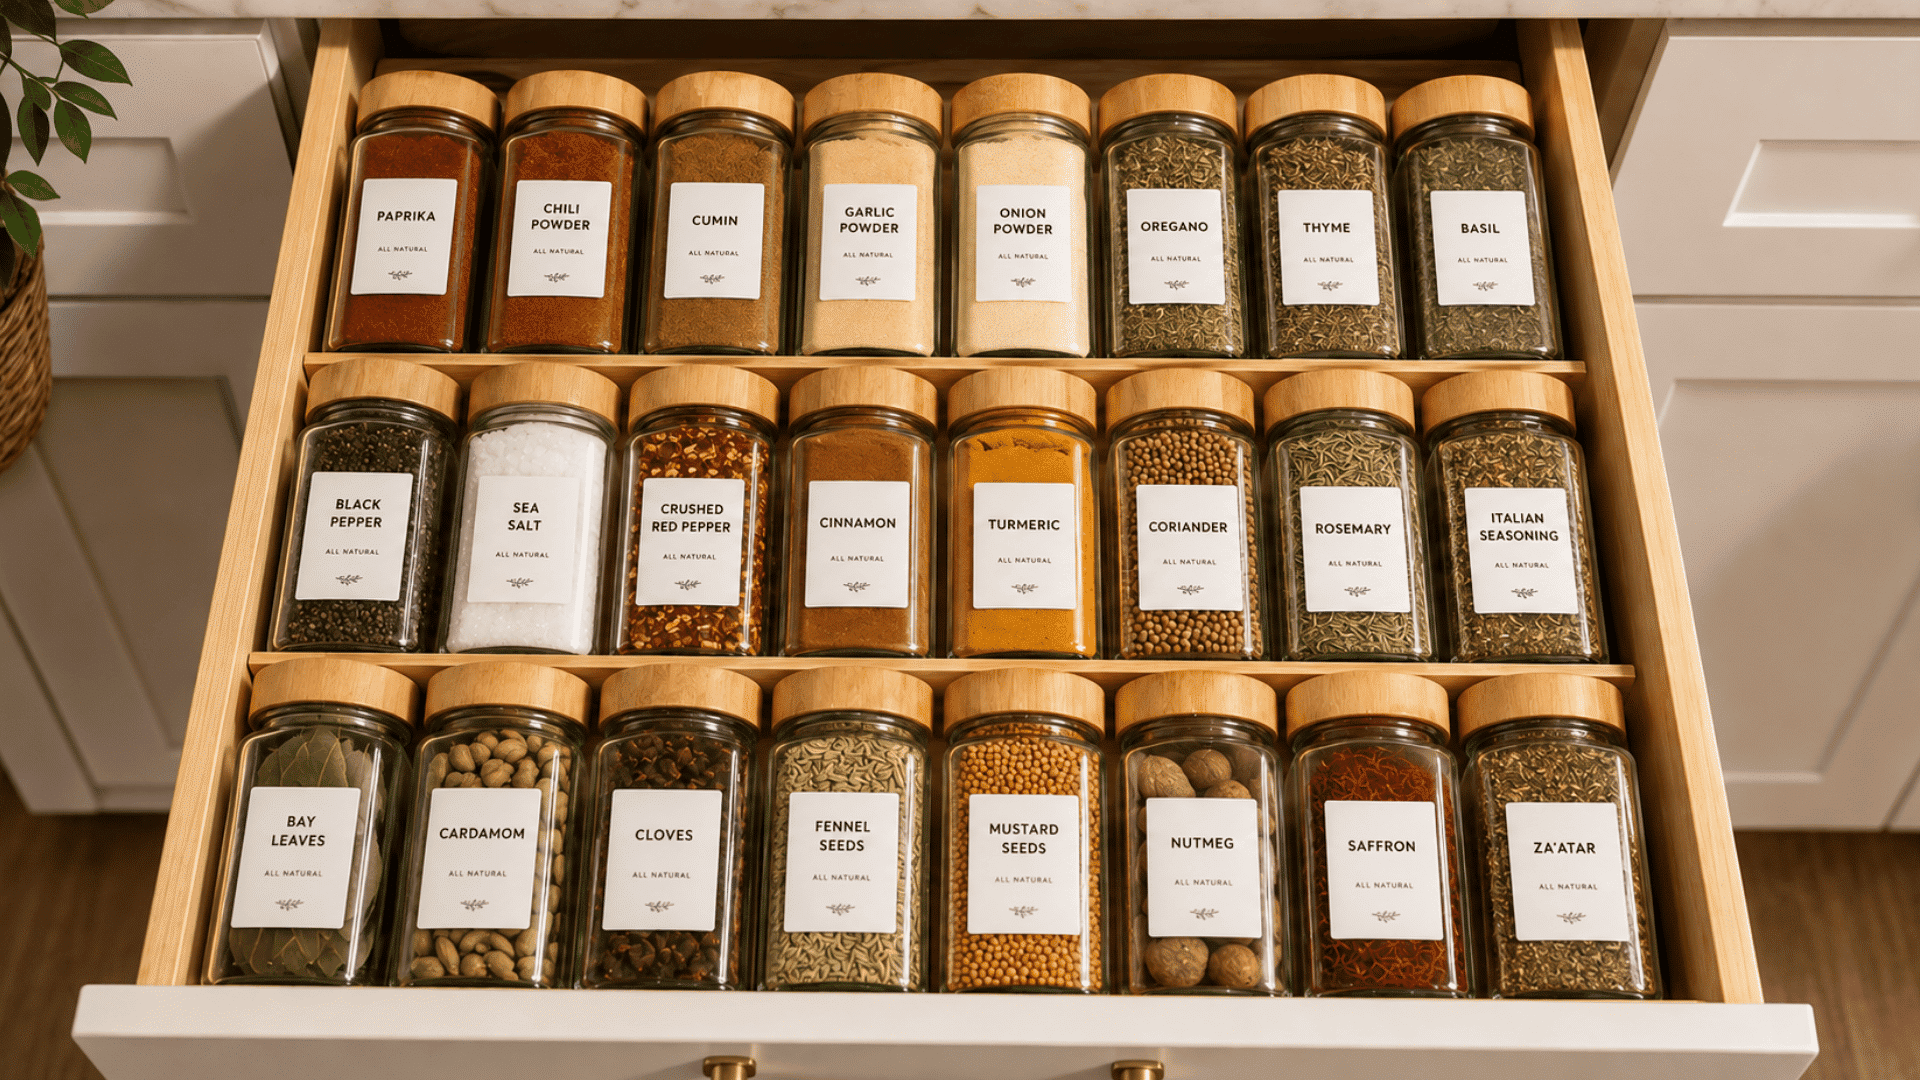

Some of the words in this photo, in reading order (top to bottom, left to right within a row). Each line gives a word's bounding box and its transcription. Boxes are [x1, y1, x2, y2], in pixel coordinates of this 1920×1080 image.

[543, 202, 580, 215] CHILI
[844, 206, 895, 218] GARLIC
[999, 207, 1047, 219] ONION
[376, 210, 436, 222] PAPRIKA
[691, 214, 739, 227] CUMIN
[530, 218, 591, 231] POWDER
[839, 221, 900, 234] POWDER
[993, 223, 1053, 236] POWDER
[1140, 220, 1209, 233] OREGANO
[1302, 221, 1351, 234] THYME
[1460, 222, 1501, 235] BASIL
[393, 245, 428, 253] NATURAL
[549, 247, 585, 255] NATURAL
[858, 251, 893, 259] NATURAL
[1150, 255, 1164, 263] ALL
[1166, 255, 1202, 263] NATURAL
[1303, 256, 1317, 264] ALL
[1319, 256, 1354, 264] NATURAL
[1473, 256, 1508, 264] NATURAL
[335, 498, 382, 511] BLACK
[512, 501, 540, 514] SEA
[660, 503, 725, 516] CRUSHED
[329, 515, 383, 529] PEPPER
[819, 516, 897, 529] CINNAMON
[987, 518, 1061, 532] TURMERIC
[1490, 512, 1545, 525] ITALIAN
[507, 519, 543, 532] SALT
[651, 520, 679, 533] RED
[681, 520, 732, 534] PEPPER
[1148, 520, 1228, 534] CORIANDER
[1314, 522, 1392, 536] ROSEMARY
[1479, 529, 1560, 542] SEASONING
[324, 548, 339, 556] ALL
[342, 548, 380, 556] NATURAL
[512, 551, 549, 559] NATURAL
[662, 553, 677, 561] ALL
[679, 553, 716, 561] NATURAL
[847, 555, 884, 563] NATURAL
[1014, 556, 1052, 564] NATURAL
[1162, 558, 1177, 566] ALL
[1179, 558, 1217, 566] NATURAL
[1327, 560, 1343, 568] ALL
[1345, 560, 1383, 568] NATURAL
[1512, 561, 1550, 569] NATURAL
[286, 815, 317, 829] BAY
[814, 819, 871, 833] FENNEL
[438, 826, 526, 840] CARDAMOM
[634, 828, 694, 842] CLOVES
[988, 822, 1060, 836] MUSTARD
[270, 833, 326, 848] LEAVES
[819, 838, 865, 852] SEEDS
[1170, 836, 1235, 850] NUTMEG
[1347, 839, 1416, 853] SAFFRON
[1001, 841, 1047, 855] SEEDS
[1533, 841, 1597, 855] ZA'ATAR
[263, 869, 279, 878] ALL
[282, 869, 322, 878] NATURAL
[448, 870, 463, 878] ALL
[466, 869, 507, 878] NATURAL
[631, 871, 647, 879] ALL
[650, 871, 691, 880] NATURAL
[830, 873, 871, 882] NATURAL
[994, 876, 1009, 884] ALL
[1012, 876, 1053, 884] NATURAL
[1174, 878, 1189, 887] ALL
[1192, 878, 1233, 887] NATURAL
[1354, 881, 1370, 889] ALL
[1373, 881, 1414, 890] NATURAL
[1538, 883, 1554, 891] ALL
[1557, 882, 1598, 891] NATURAL
